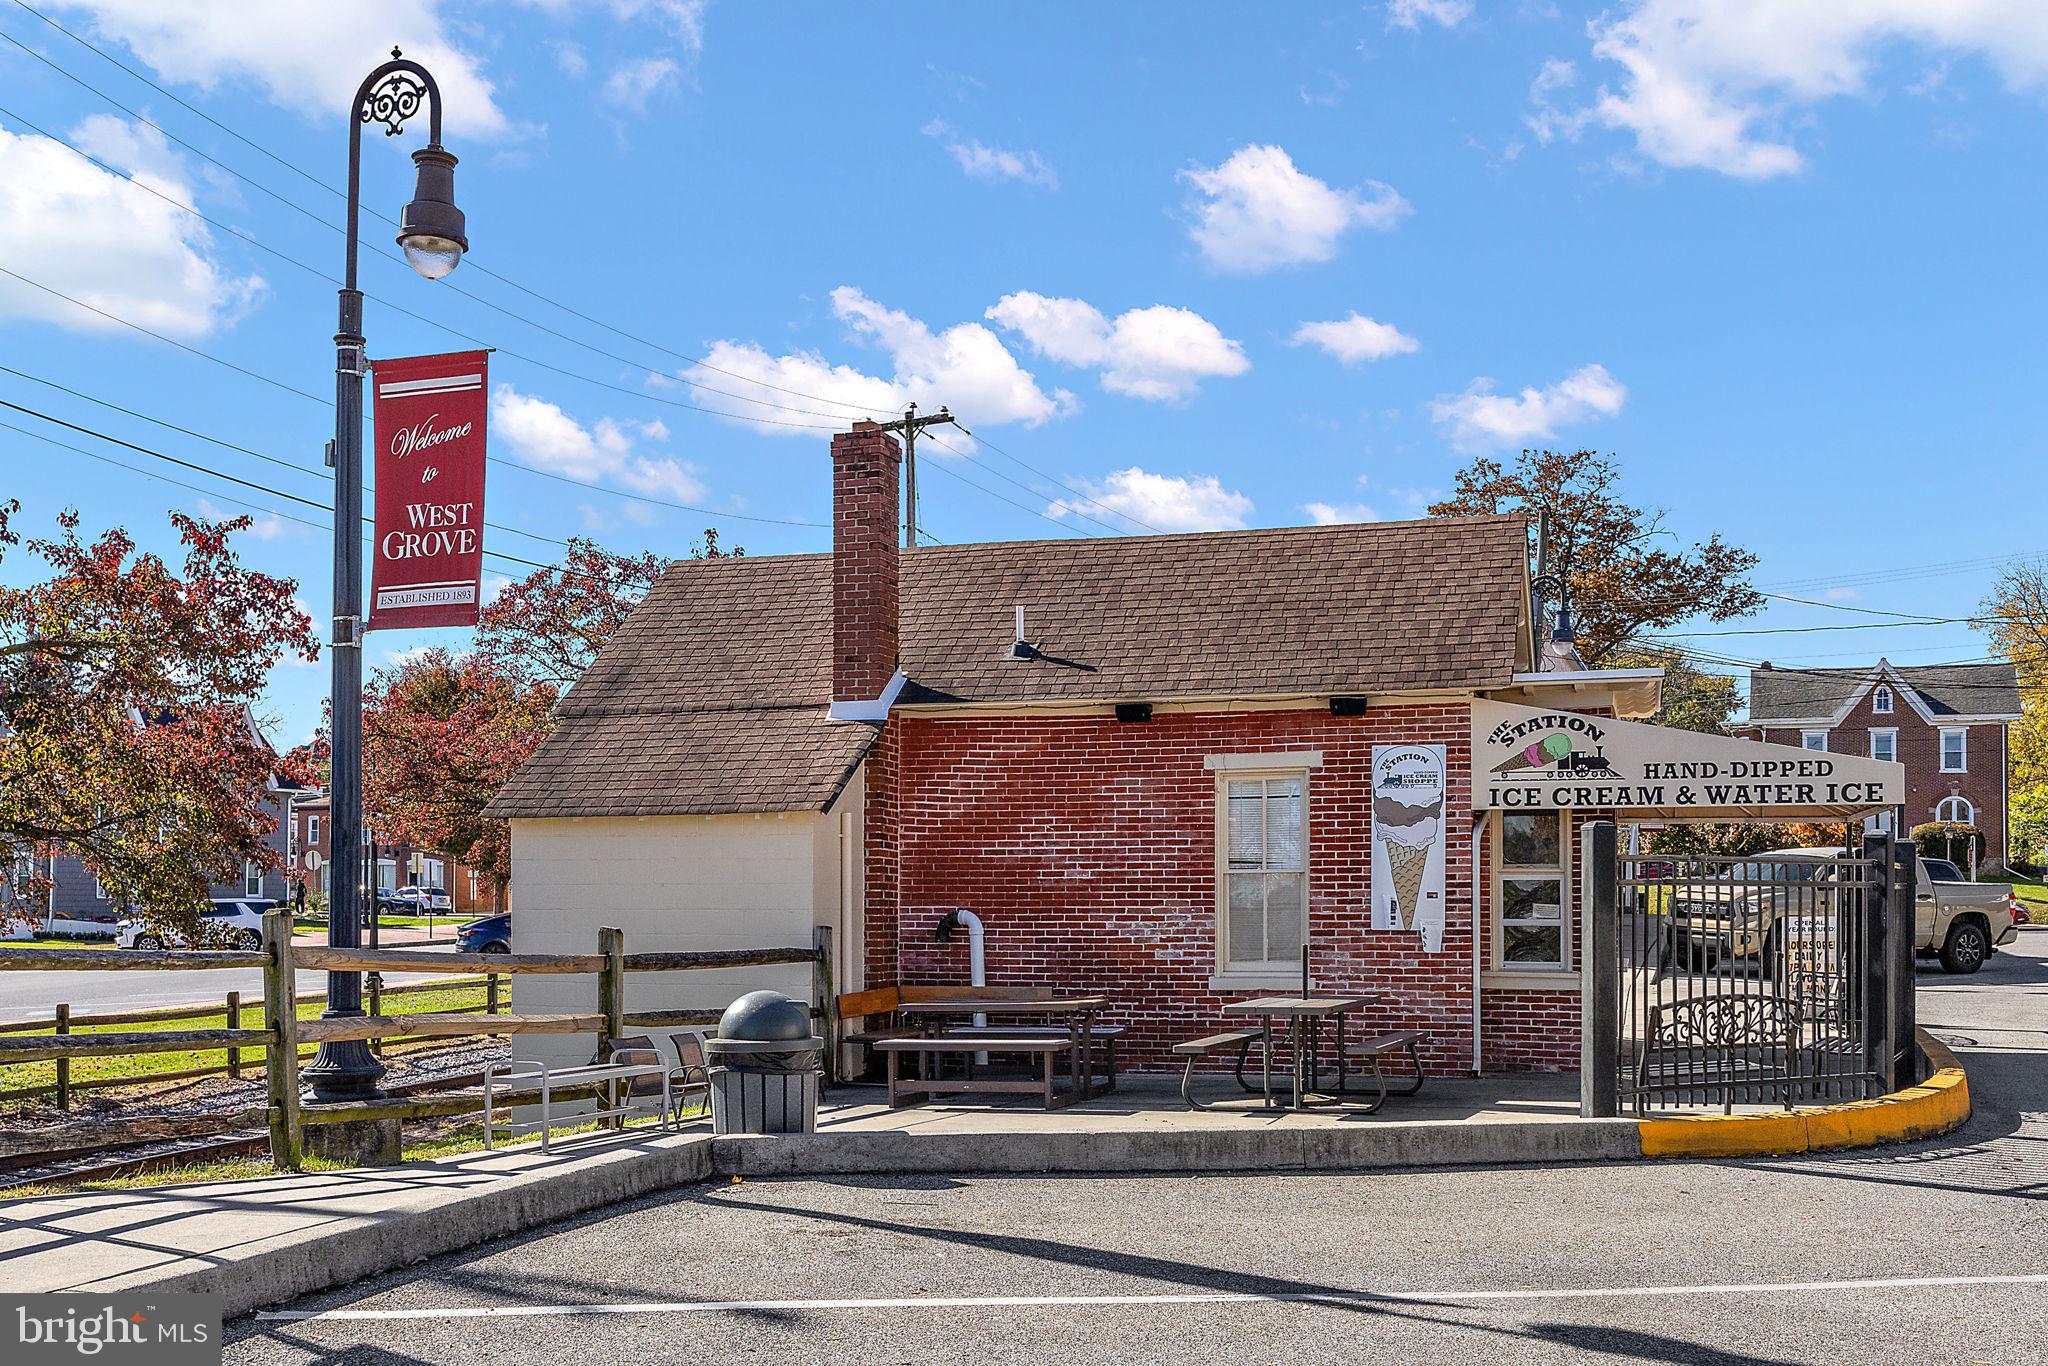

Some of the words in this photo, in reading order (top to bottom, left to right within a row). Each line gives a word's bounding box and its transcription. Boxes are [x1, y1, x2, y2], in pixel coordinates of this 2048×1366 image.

[390, 413, 472, 459] Welcome
[421, 465, 438, 484] to
[406, 502, 474, 529] WEST
[382, 528, 477, 561] GROVE
[380, 590, 451, 606] ESTABLISHED
[452, 589, 472, 602] 1893
[1487, 718, 1514, 746] THE
[1499, 715, 1606, 749] STATION
[1380, 758, 1390, 771] THE
[1385, 753, 1430, 771] STATION
[1643, 759, 1835, 781] HAND-DIPPED
[1488, 787, 1542, 808] ICE
[1551, 784, 1665, 807] CREAM
[1675, 785, 1698, 806] &
[1703, 783, 1821, 805] WATER
[1825, 782, 1886, 803] ICE
